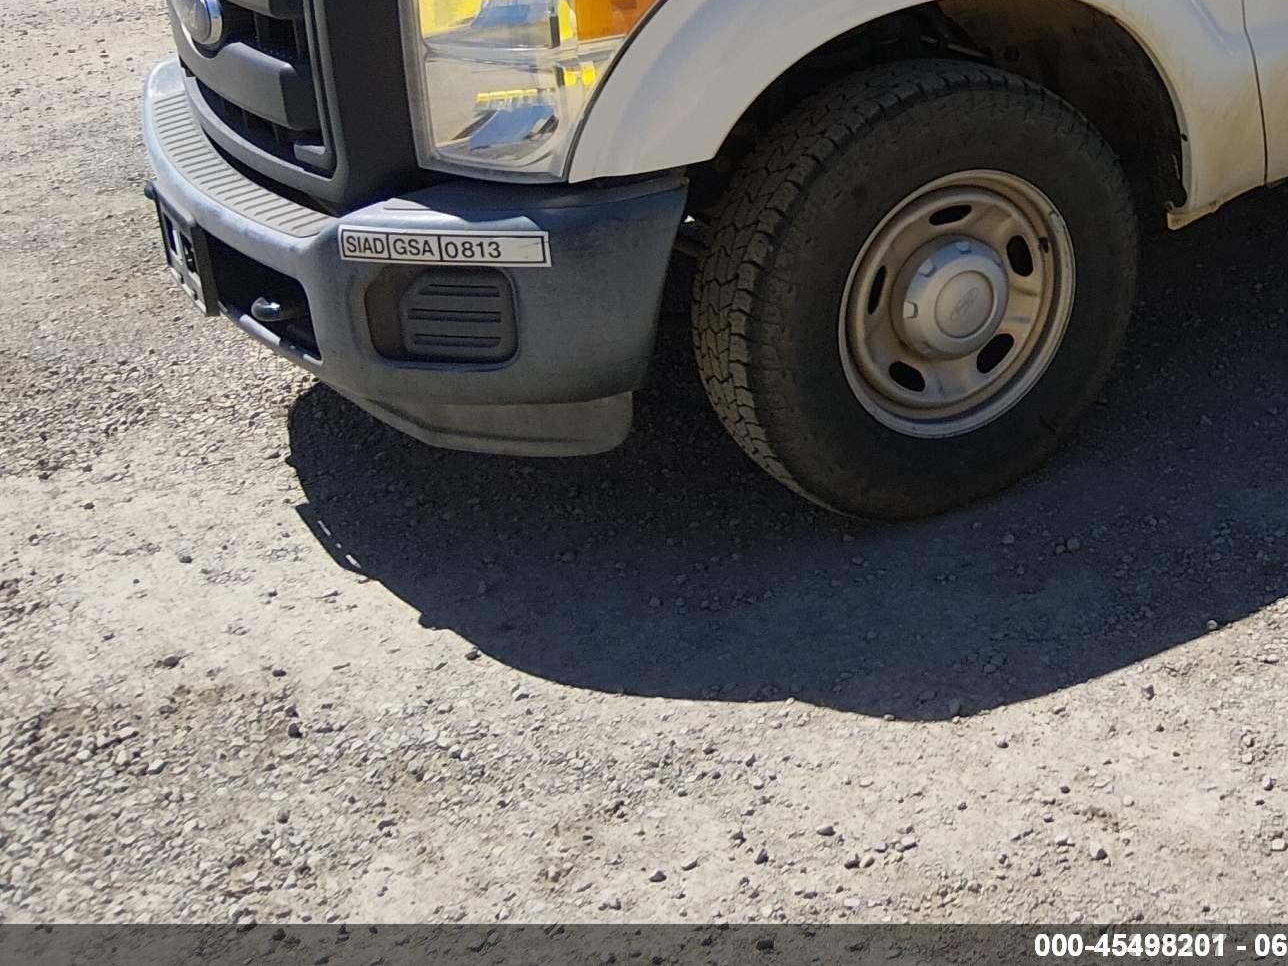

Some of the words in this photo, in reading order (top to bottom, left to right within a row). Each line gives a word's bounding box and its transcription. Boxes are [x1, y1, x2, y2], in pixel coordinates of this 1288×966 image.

[346, 235, 385, 255] SIAD
[393, 238, 435, 258] GSA
[444, 240, 502, 259] 0813
